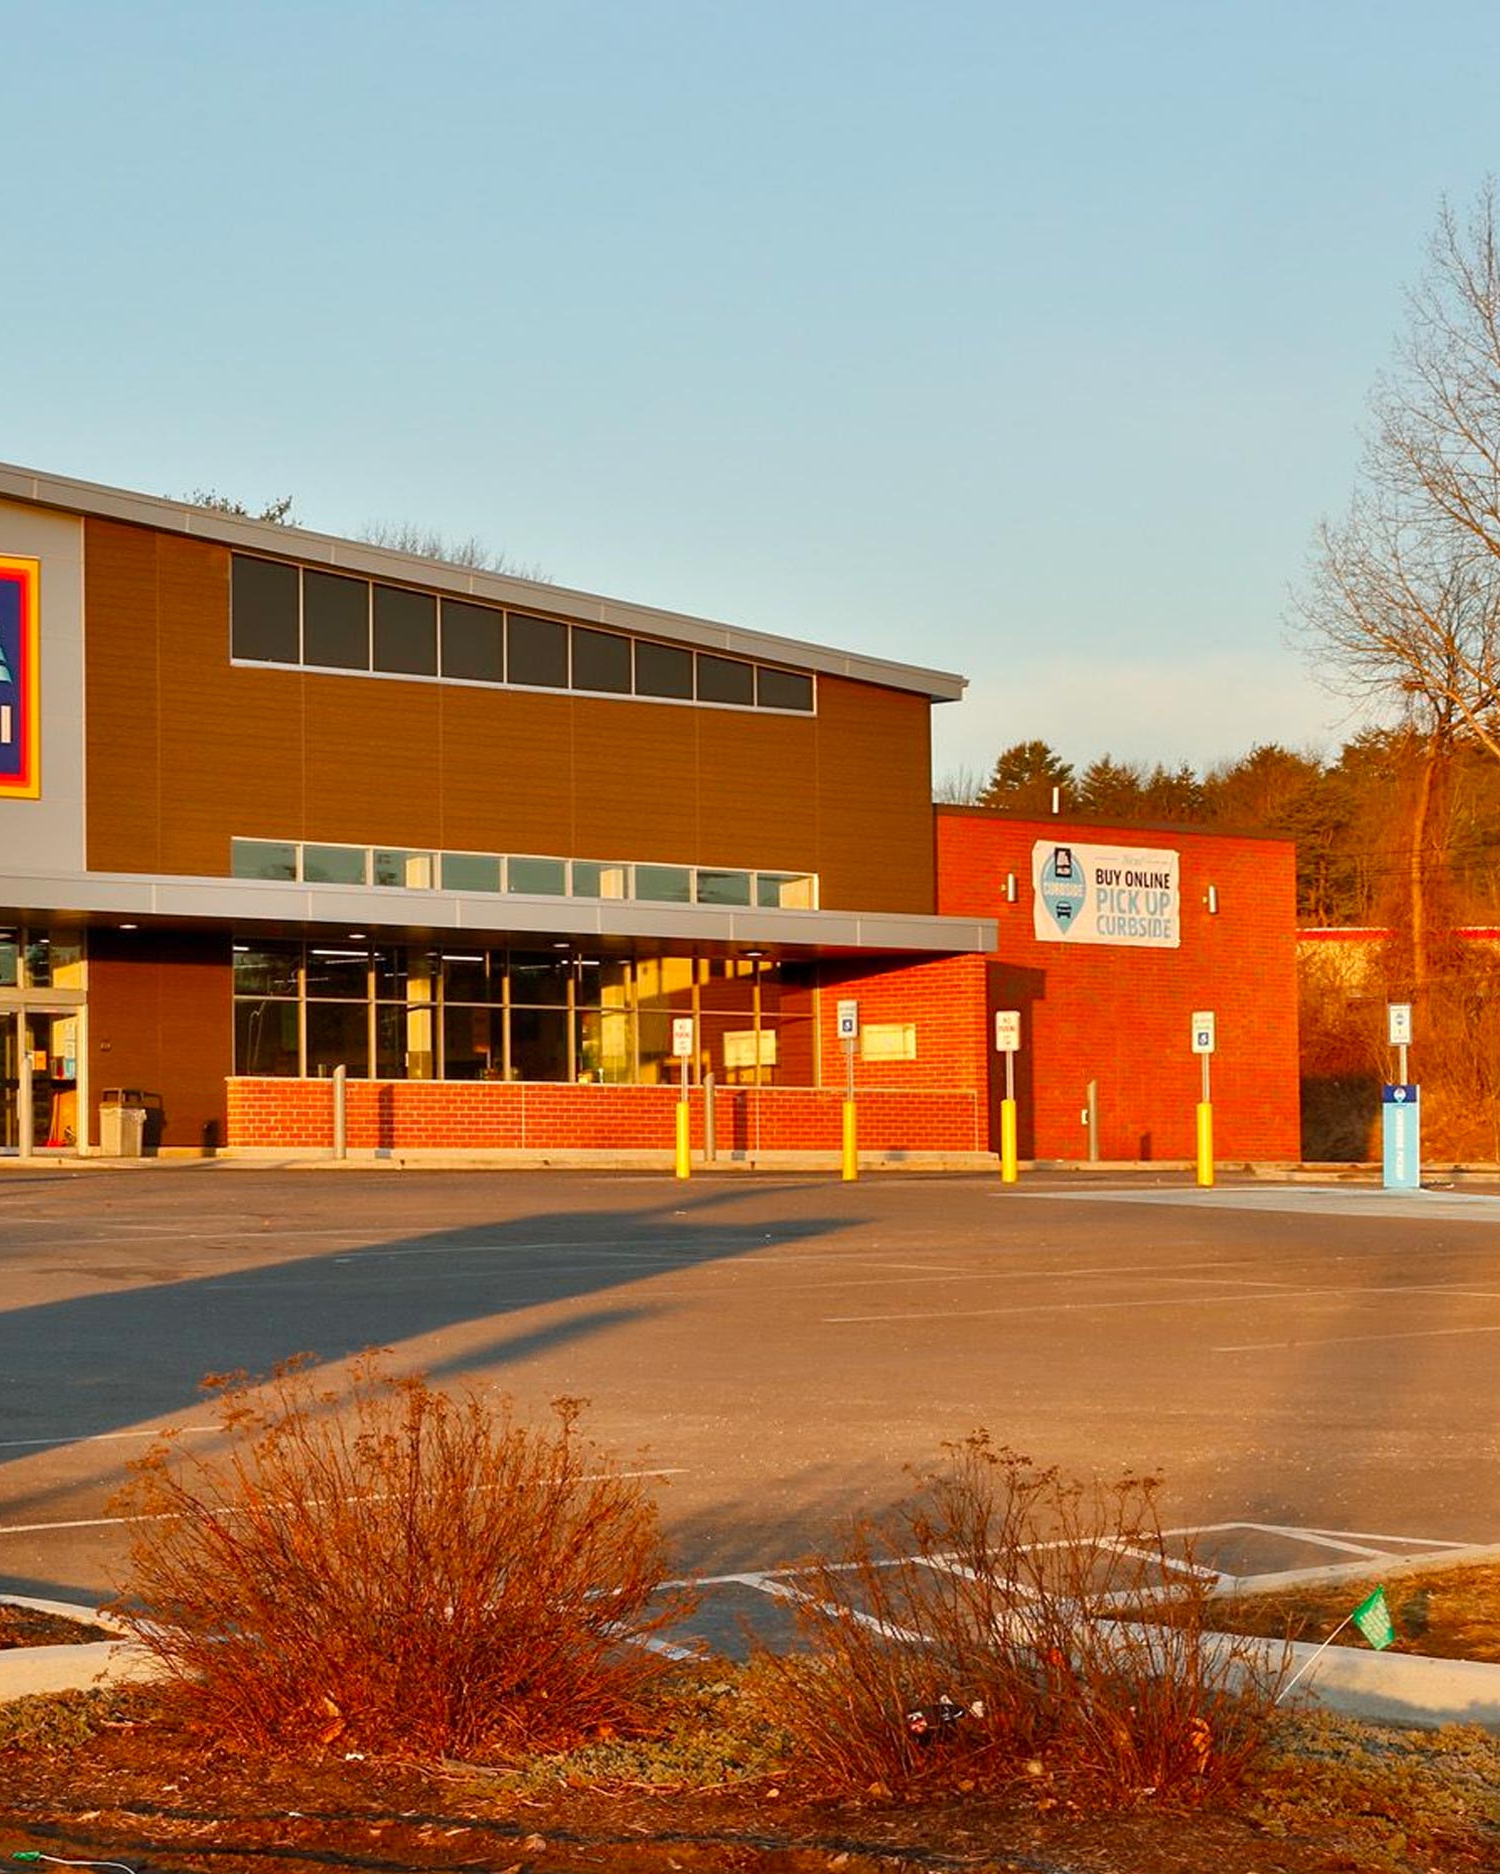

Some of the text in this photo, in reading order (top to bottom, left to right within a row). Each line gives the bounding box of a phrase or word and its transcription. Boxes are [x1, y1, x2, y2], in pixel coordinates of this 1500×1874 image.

[1095, 868, 1170, 889] BUY ONLINE
[1096, 887, 1171, 917] PICK UP
[1096, 914, 1171, 938] CURBSIDE
